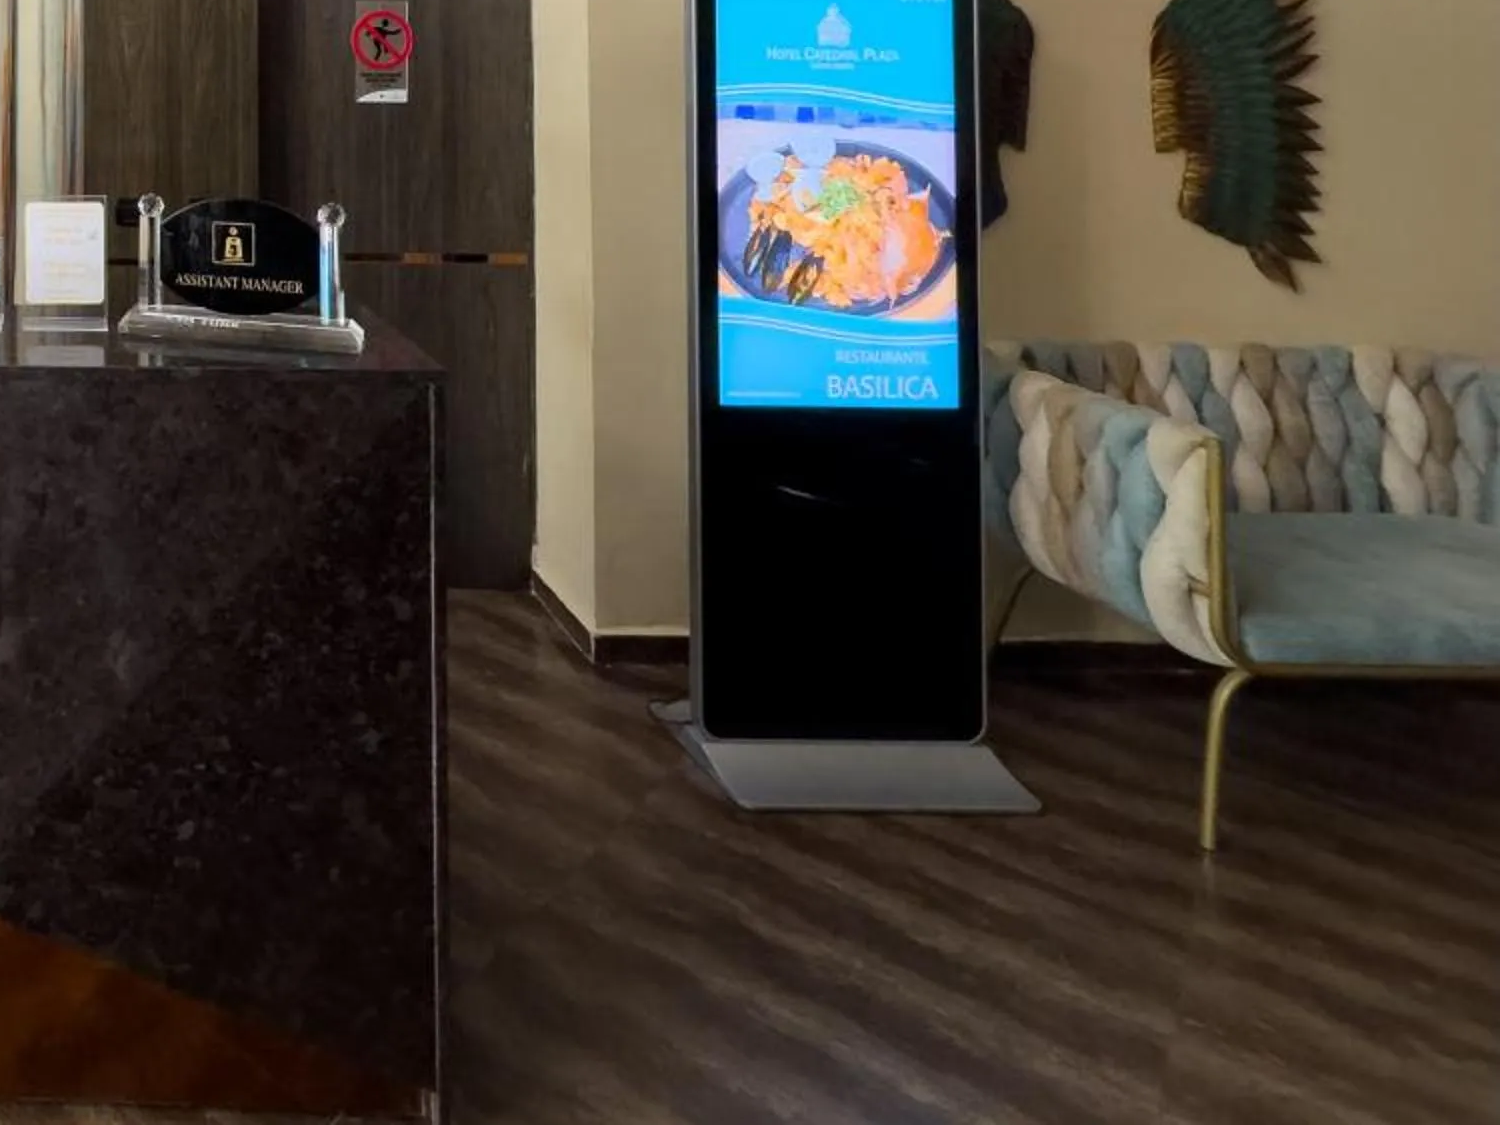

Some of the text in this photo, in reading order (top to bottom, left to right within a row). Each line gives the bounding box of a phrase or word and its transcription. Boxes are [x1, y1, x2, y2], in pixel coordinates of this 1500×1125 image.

[176, 273, 304, 294] ASSISTANT MANAGER
[836, 350, 929, 364] RESTAURANTE
[827, 375, 939, 399] BASILICA
